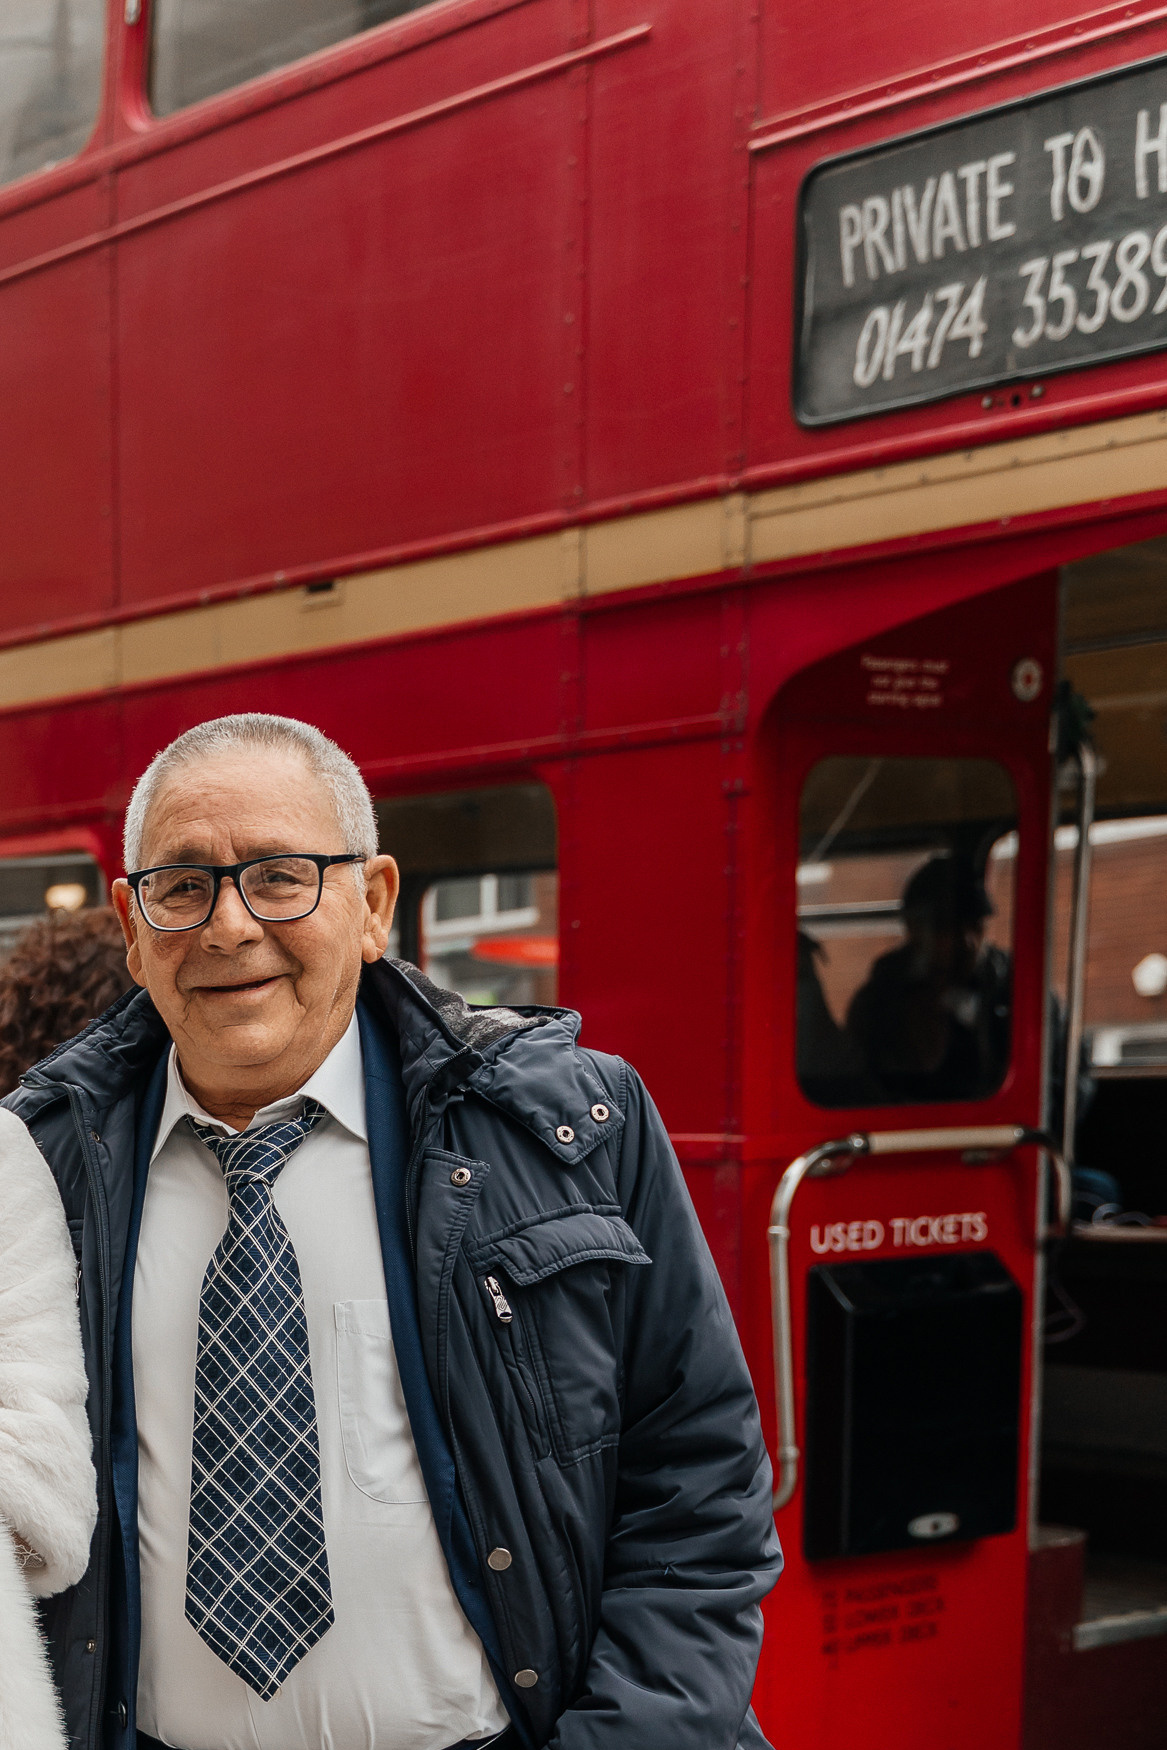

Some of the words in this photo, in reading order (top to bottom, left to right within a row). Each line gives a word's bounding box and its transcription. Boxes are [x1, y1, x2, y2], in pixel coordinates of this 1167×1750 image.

[839, 151, 1016, 288] PRIVATE
[1043, 125, 1106, 222] TO
[853, 273, 988, 389] 01474
[810, 1220, 885, 1254] USED
[889, 1211, 988, 1247] TICKETS
